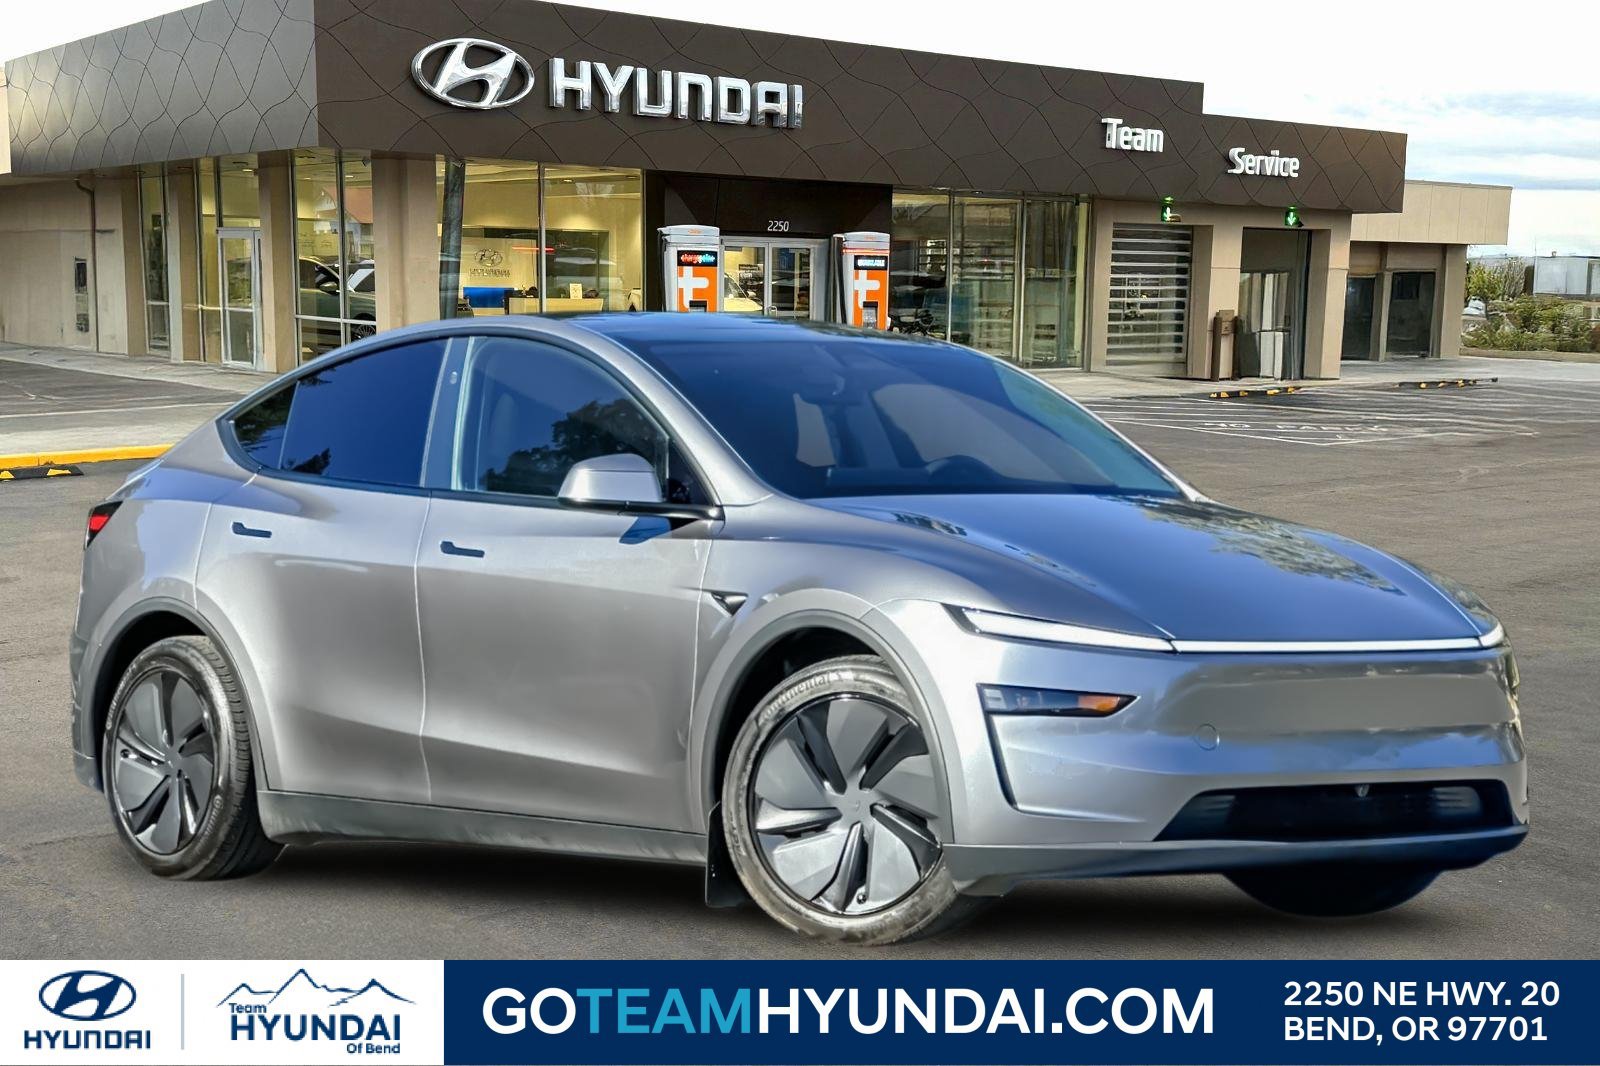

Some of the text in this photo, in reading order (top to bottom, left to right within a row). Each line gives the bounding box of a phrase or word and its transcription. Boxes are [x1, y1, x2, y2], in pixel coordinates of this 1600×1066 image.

[549, 57, 803, 128] HYUNDAI
[1101, 118, 1164, 153] Team
[1228, 147, 1300, 178] Service
[767, 220, 790, 232] 2250
